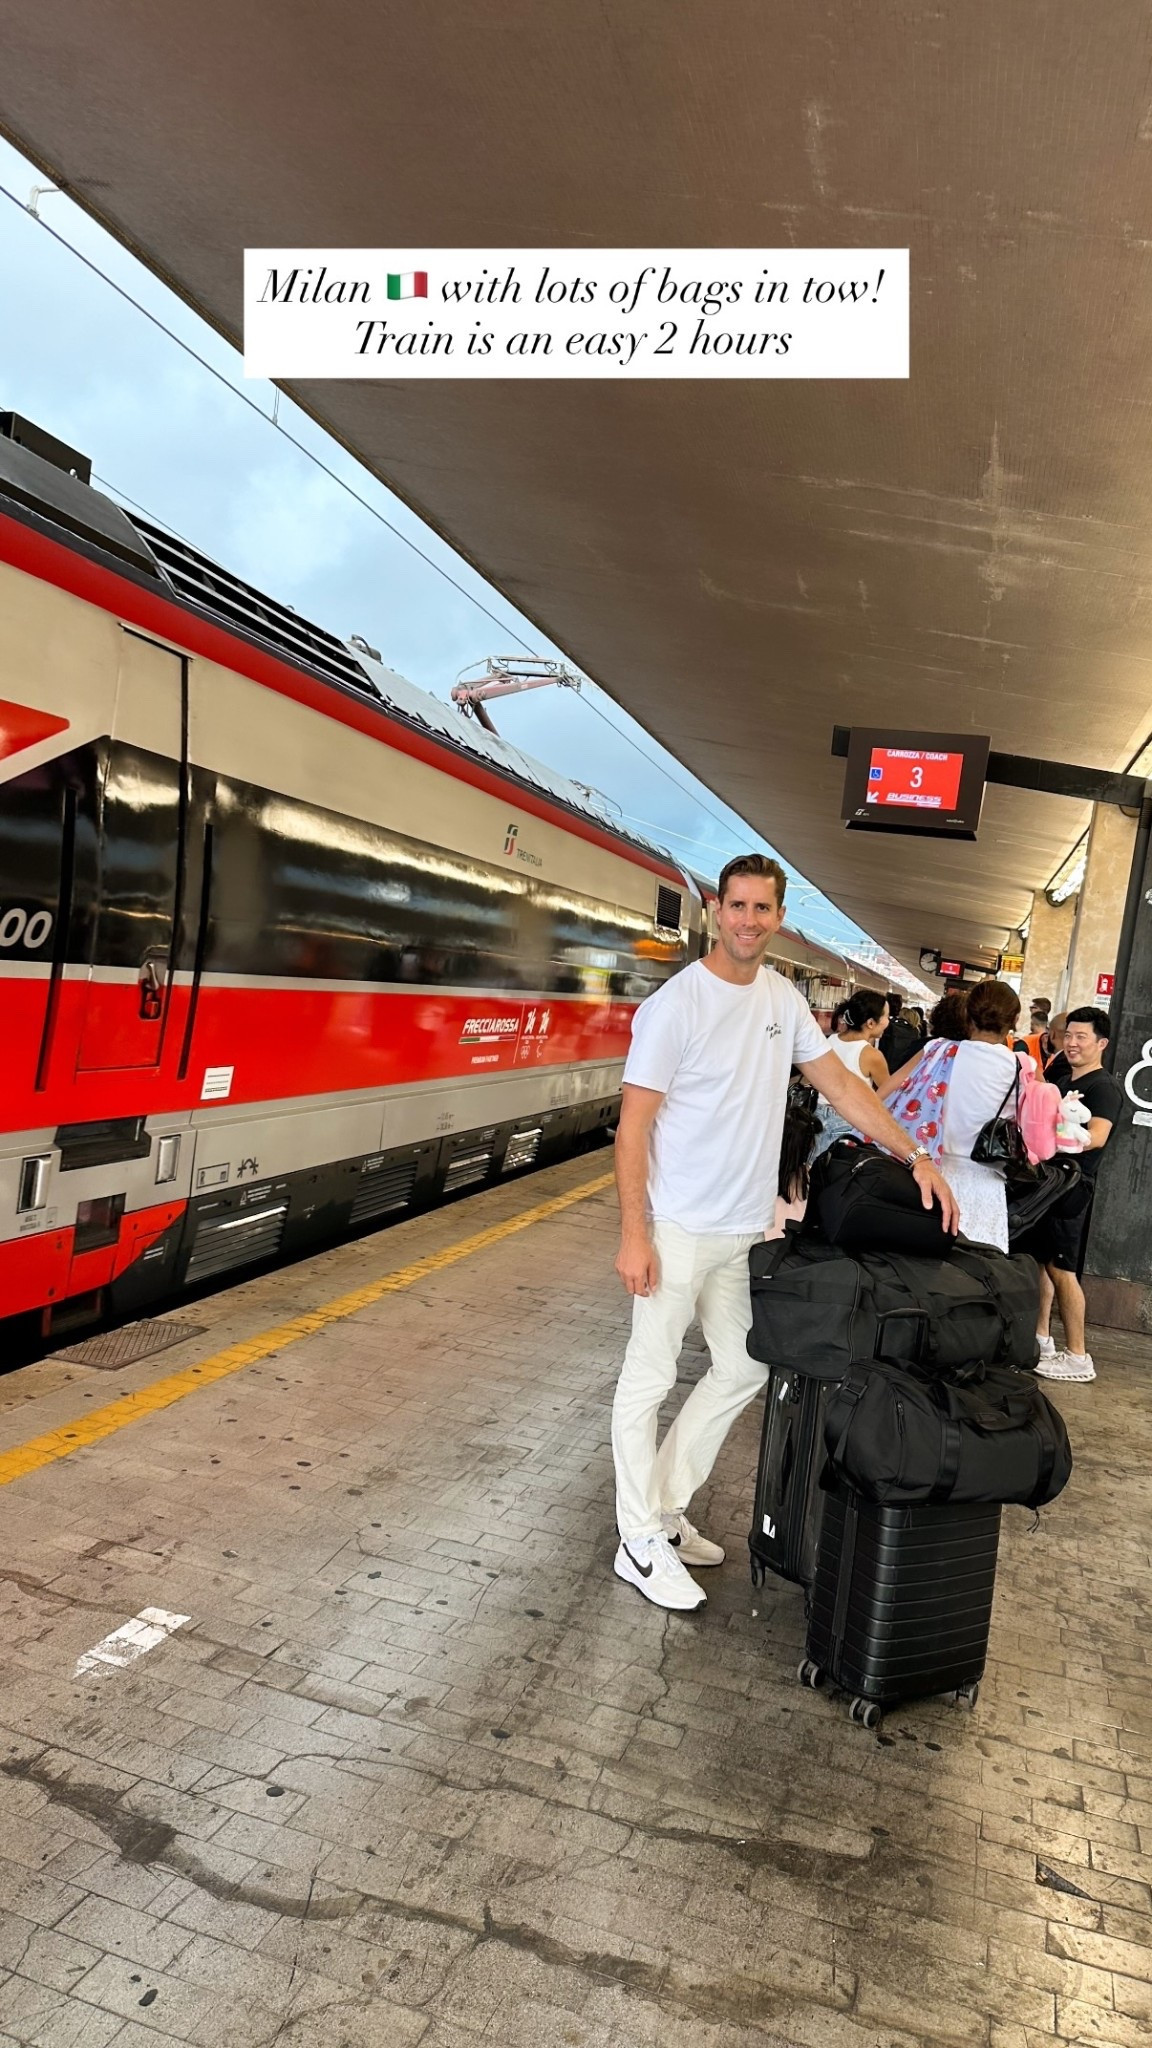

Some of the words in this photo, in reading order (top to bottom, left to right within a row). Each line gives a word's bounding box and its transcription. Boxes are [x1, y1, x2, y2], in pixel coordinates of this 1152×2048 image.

[887, 750, 920, 759] CARROZZA
[925, 752, 948, 761] COACH
[910, 767, 923, 788] 3
[0, 908, 53, 948] 00
[461, 1018, 520, 1035] FRECCIAROSSA
